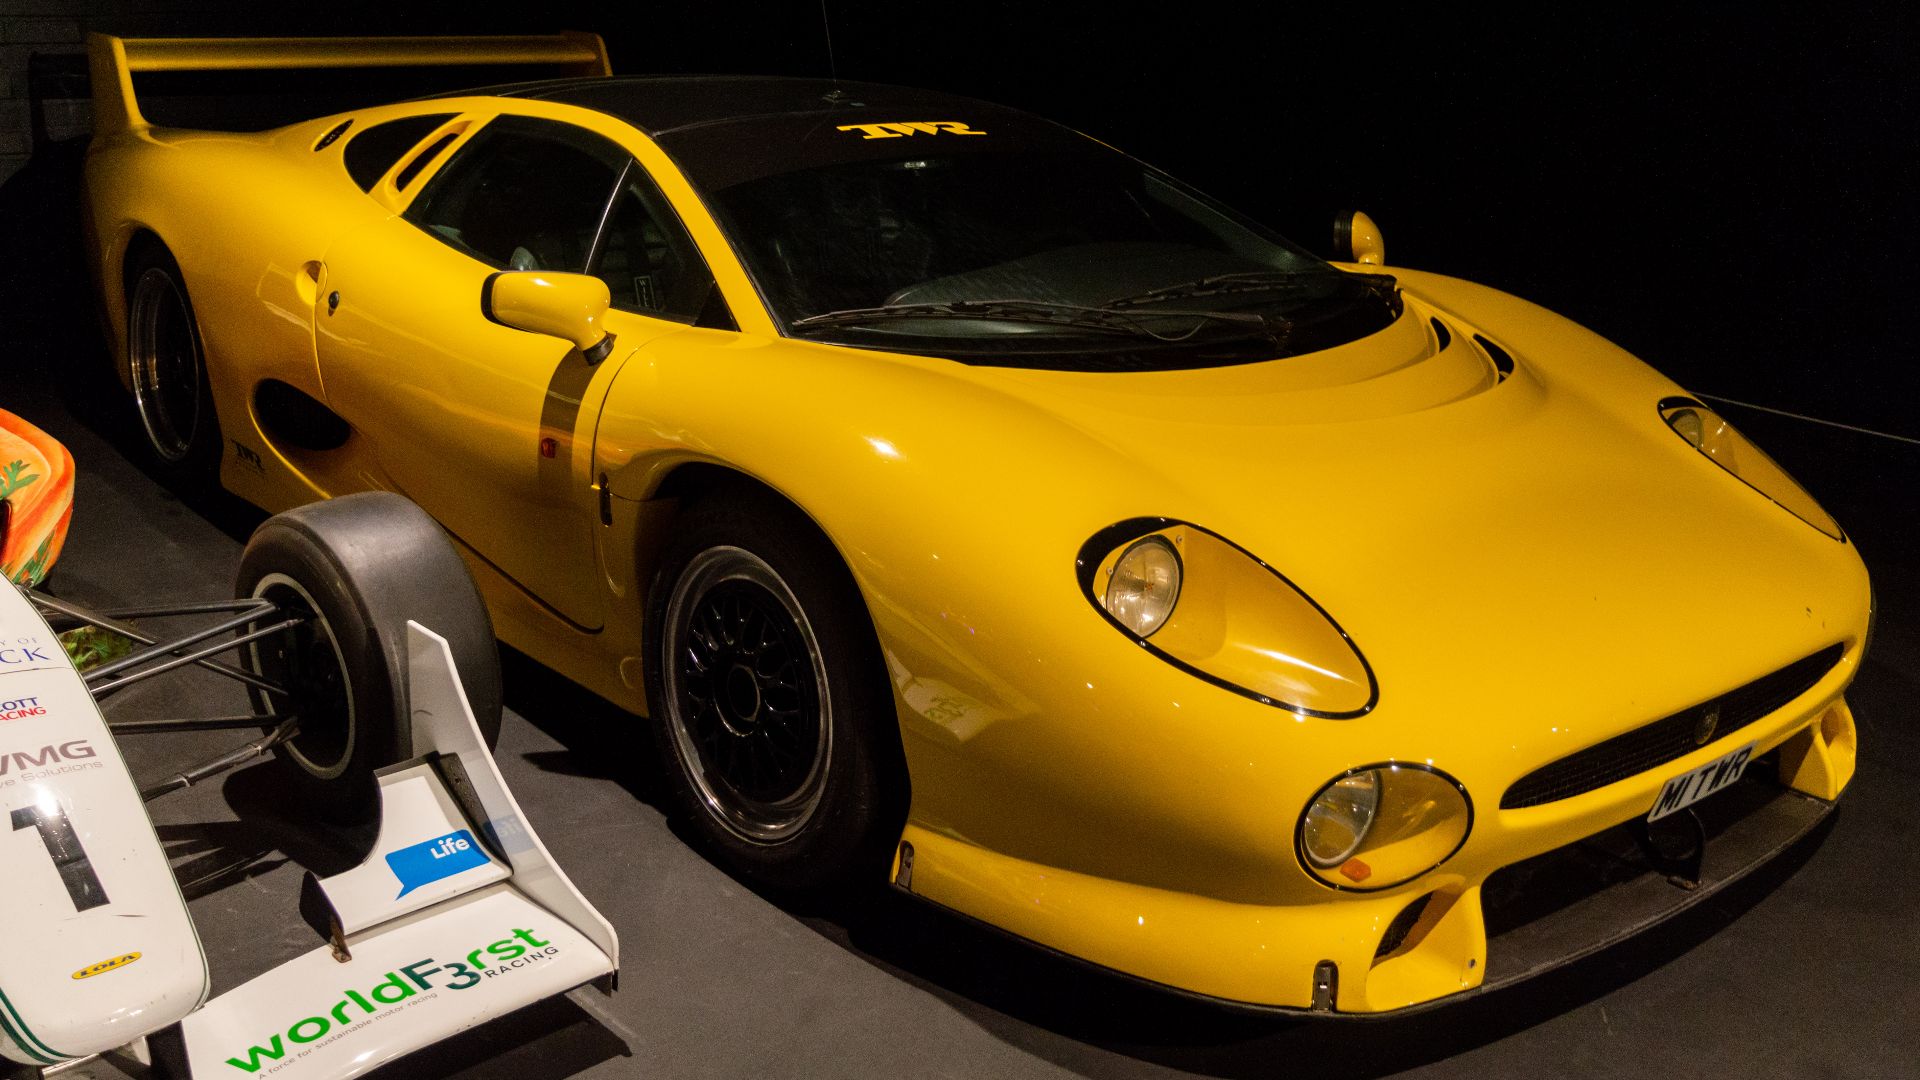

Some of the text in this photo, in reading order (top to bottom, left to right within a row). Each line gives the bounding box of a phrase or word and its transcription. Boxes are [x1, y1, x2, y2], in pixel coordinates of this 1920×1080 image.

[836, 121, 987, 139] TWR
[0, 697, 38, 713] OTT
[21, 761, 104, 782] Solutions
[1692, 746, 1753, 800] TWR
[10, 800, 111, 912] 1
[430, 837, 470, 859] Life
[80, 955, 136, 977] LOLA
[484, 946, 559, 978] RACING
[268, 1057, 296, 1073] force
[297, 1048, 312, 1059] for
[315, 1019, 372, 1050] sustainable
[375, 1005, 404, 1021] motor
[407, 992, 438, 1007] racing
